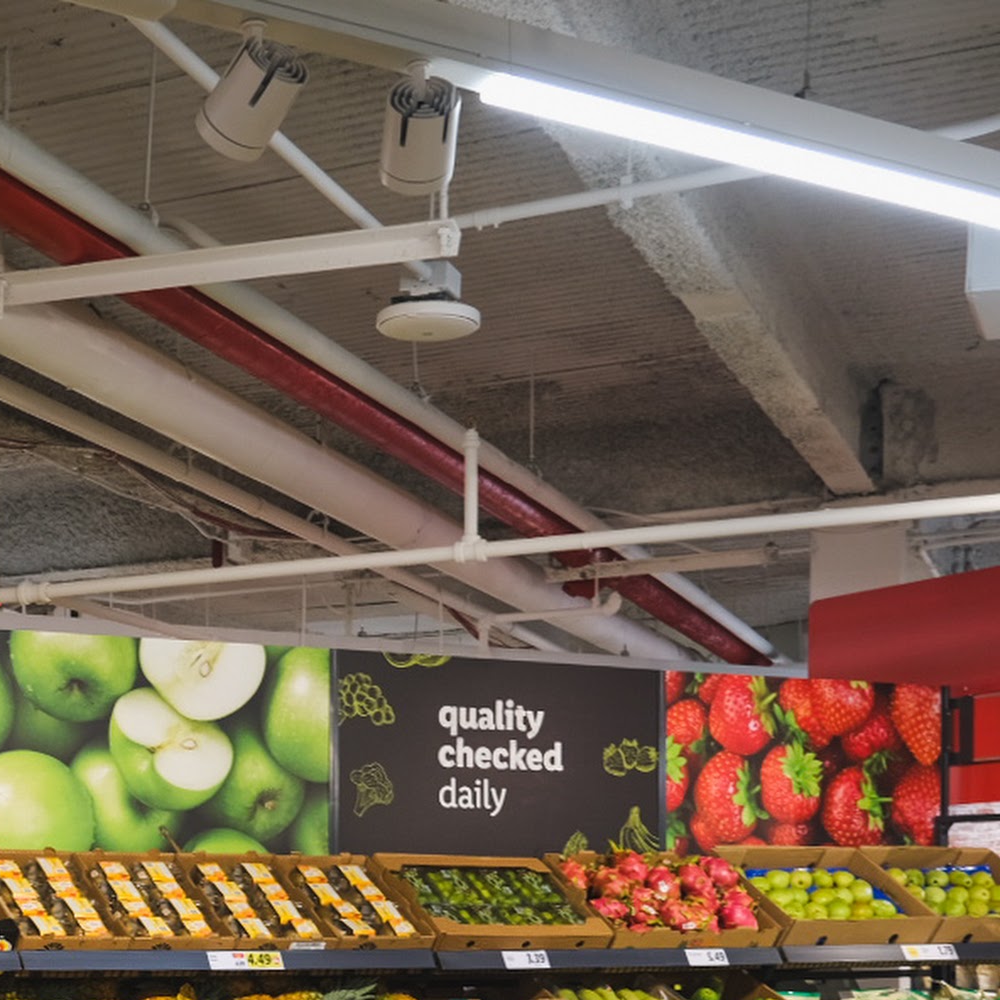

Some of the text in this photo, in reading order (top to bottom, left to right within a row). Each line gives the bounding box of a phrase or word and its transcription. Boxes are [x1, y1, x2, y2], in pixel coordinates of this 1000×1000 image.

[438, 699, 545, 740] quality
[437, 737, 564, 771] checked
[438, 777, 507, 817] daily
[247, 953, 272, 966] 4.49
